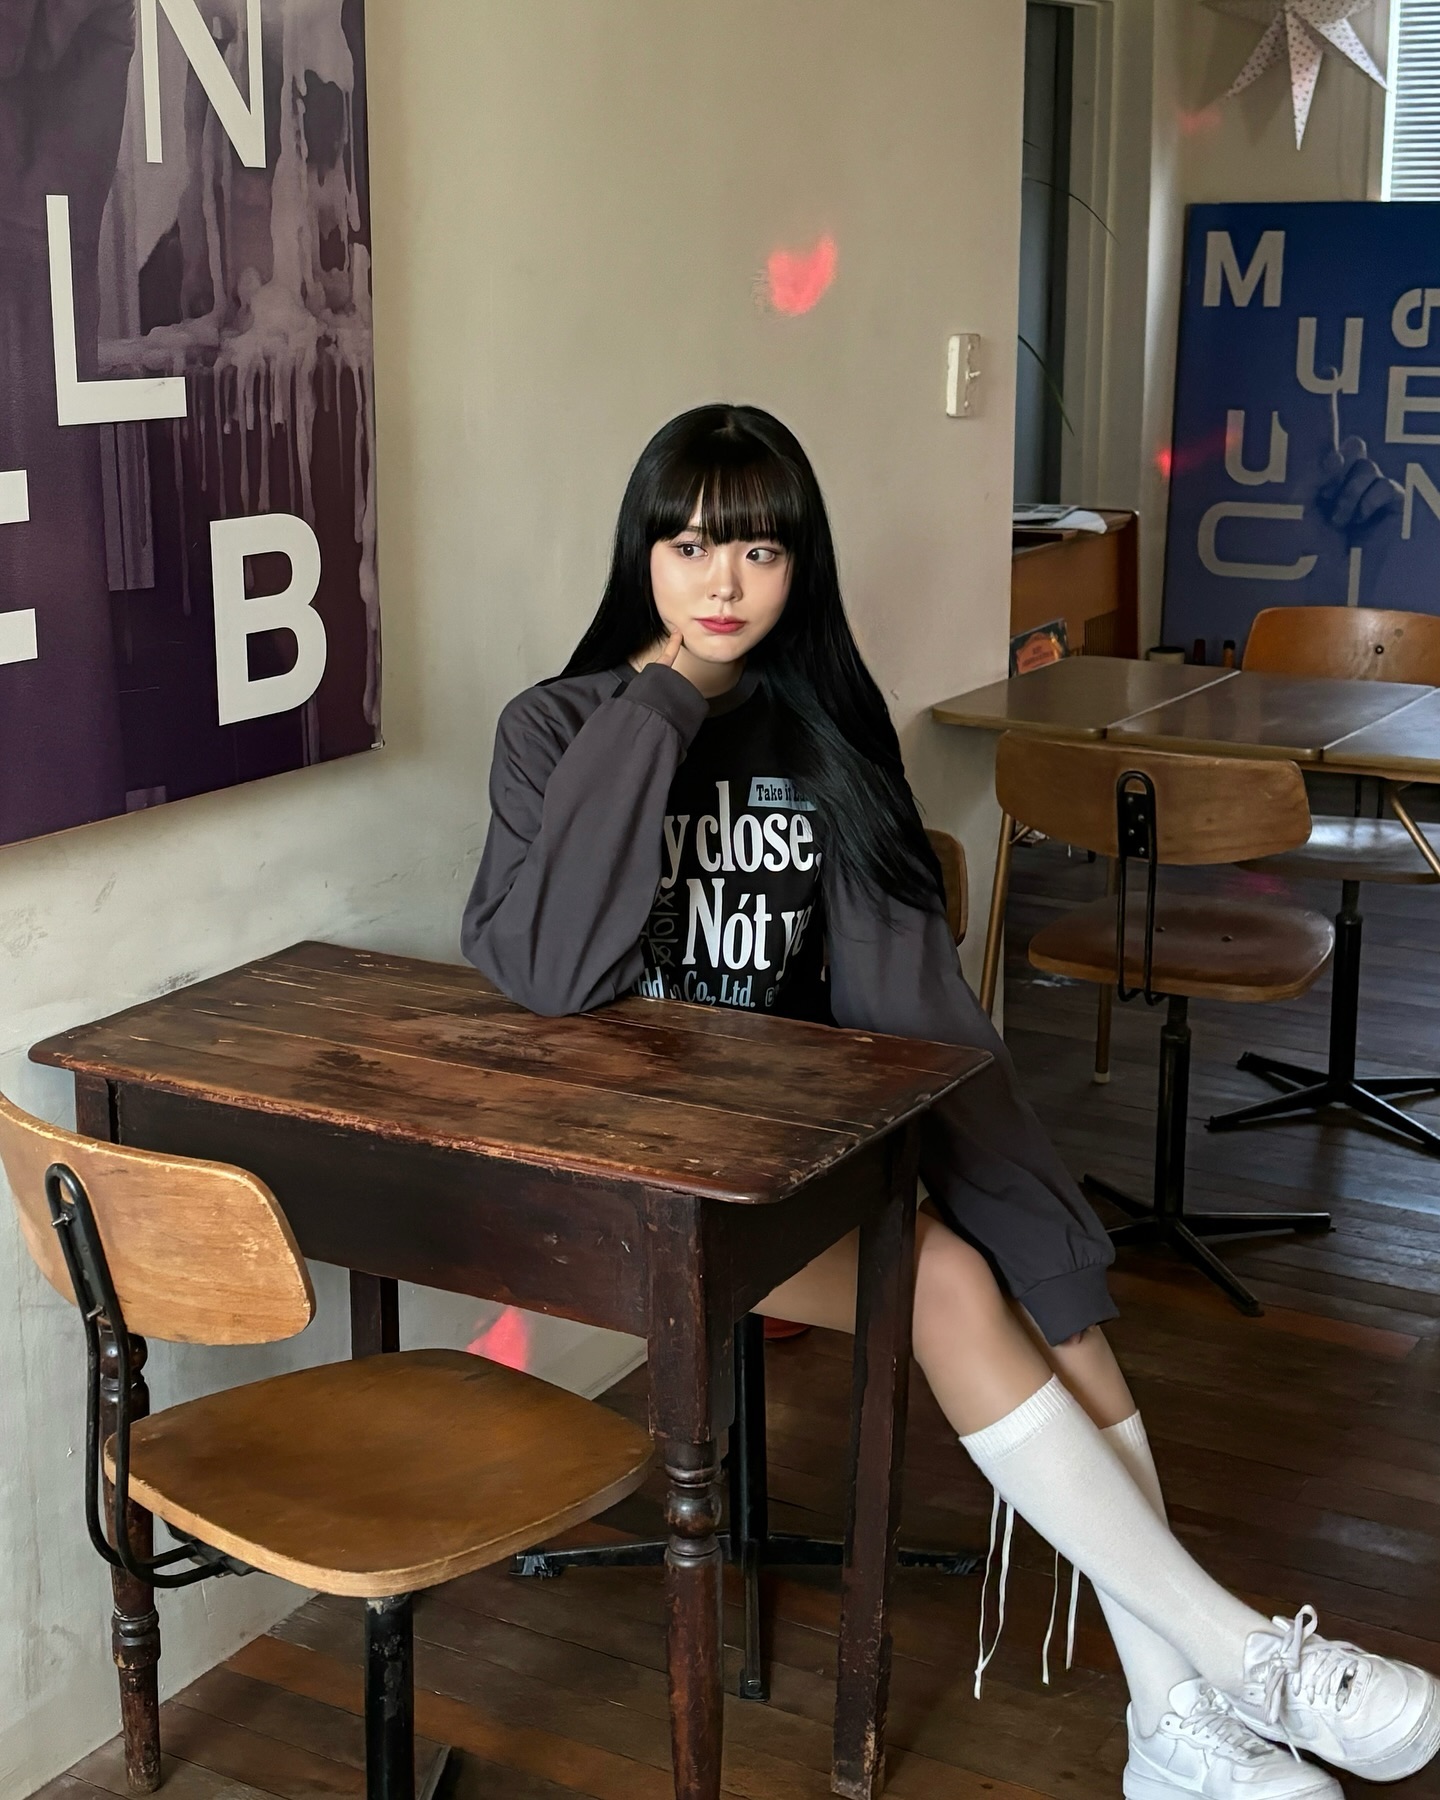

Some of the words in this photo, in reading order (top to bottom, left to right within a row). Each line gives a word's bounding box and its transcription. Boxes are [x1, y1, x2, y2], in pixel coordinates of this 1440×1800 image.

[142, 0, 267, 169] N
[45, 195, 188, 427] L
[1203, 230, 1286, 308] M
[210, 513, 328, 727] B
[756, 784, 783, 802] Take
[719, 974, 756, 1008] Ltd.
